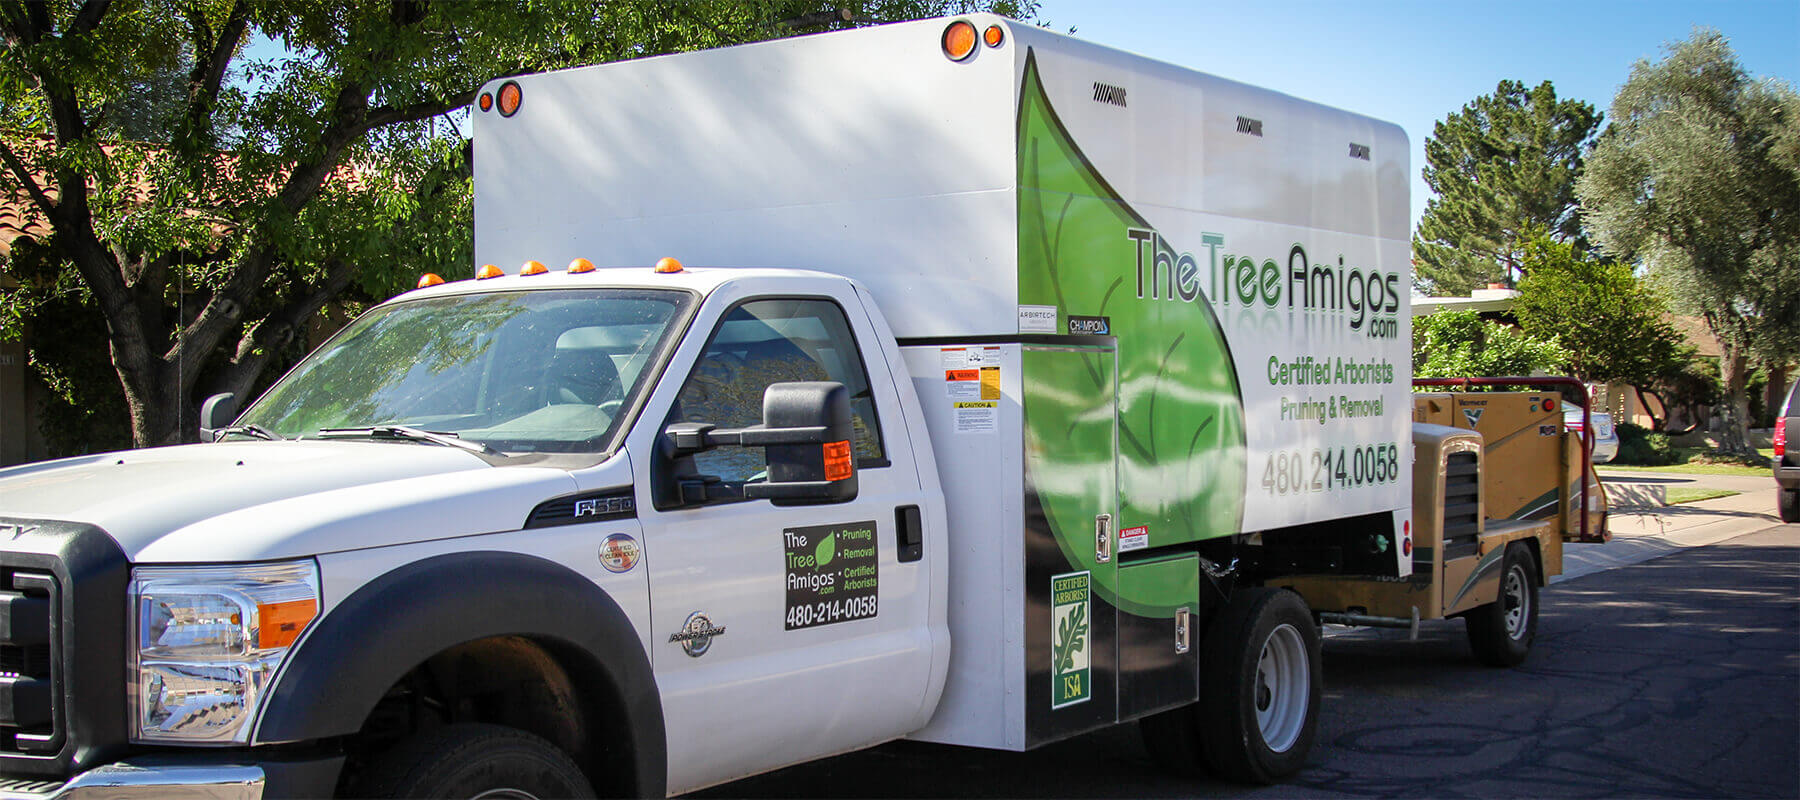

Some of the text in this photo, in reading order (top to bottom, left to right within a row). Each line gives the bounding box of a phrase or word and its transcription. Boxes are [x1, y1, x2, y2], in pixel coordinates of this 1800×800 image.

[1128, 228, 1400, 332] The Tree Amigos
[1367, 317, 1398, 339] .com
[1267, 355, 1394, 385] Certified Arborists
[1281, 394, 1384, 425] Pruning & Removal
[1262, 442, 1399, 495] 480.214.0058
[785, 532, 808, 549] The
[842, 528, 872, 541] Pruning
[786, 552, 815, 569] Tree
[843, 544, 875, 560] Removal
[844, 563, 876, 578] Certified
[787, 572, 835, 592] Amigos
[843, 577, 877, 591] Arborists
[1054, 576, 1088, 592] CERTIFIED
[1055, 588, 1088, 603] ARBORIST
[786, 595, 877, 627] 480-214-0058
[1063, 673, 1082, 699] ISA
